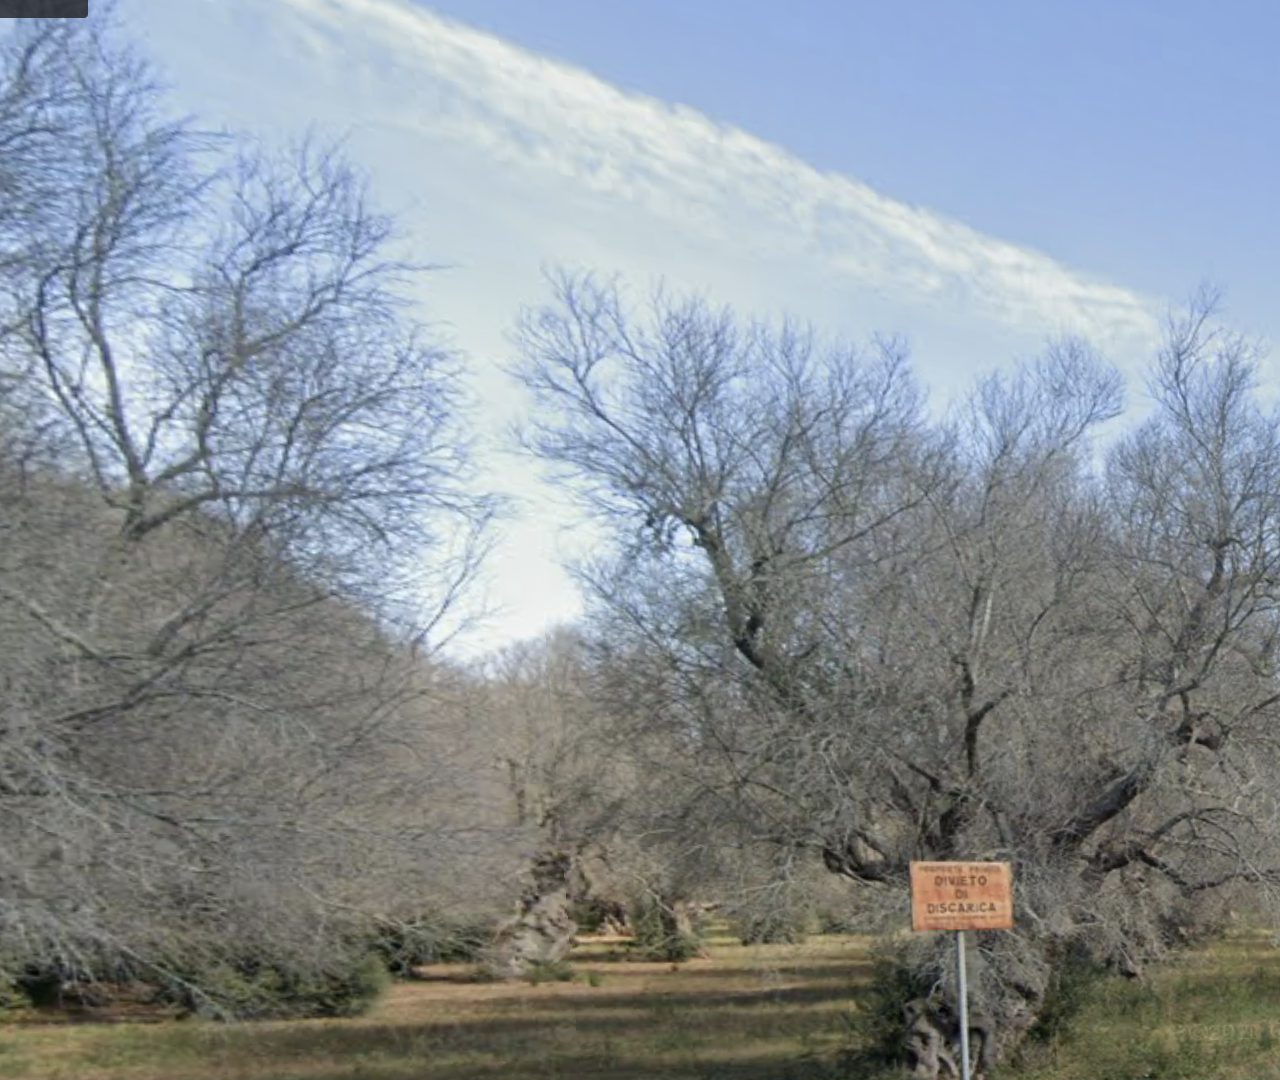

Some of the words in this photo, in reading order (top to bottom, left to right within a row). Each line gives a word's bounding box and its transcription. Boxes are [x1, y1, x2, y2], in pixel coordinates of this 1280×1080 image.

[935, 875, 987, 886] DIVIETO
[955, 889, 968, 899] DI
[928, 903, 997, 913] DISCARICA
